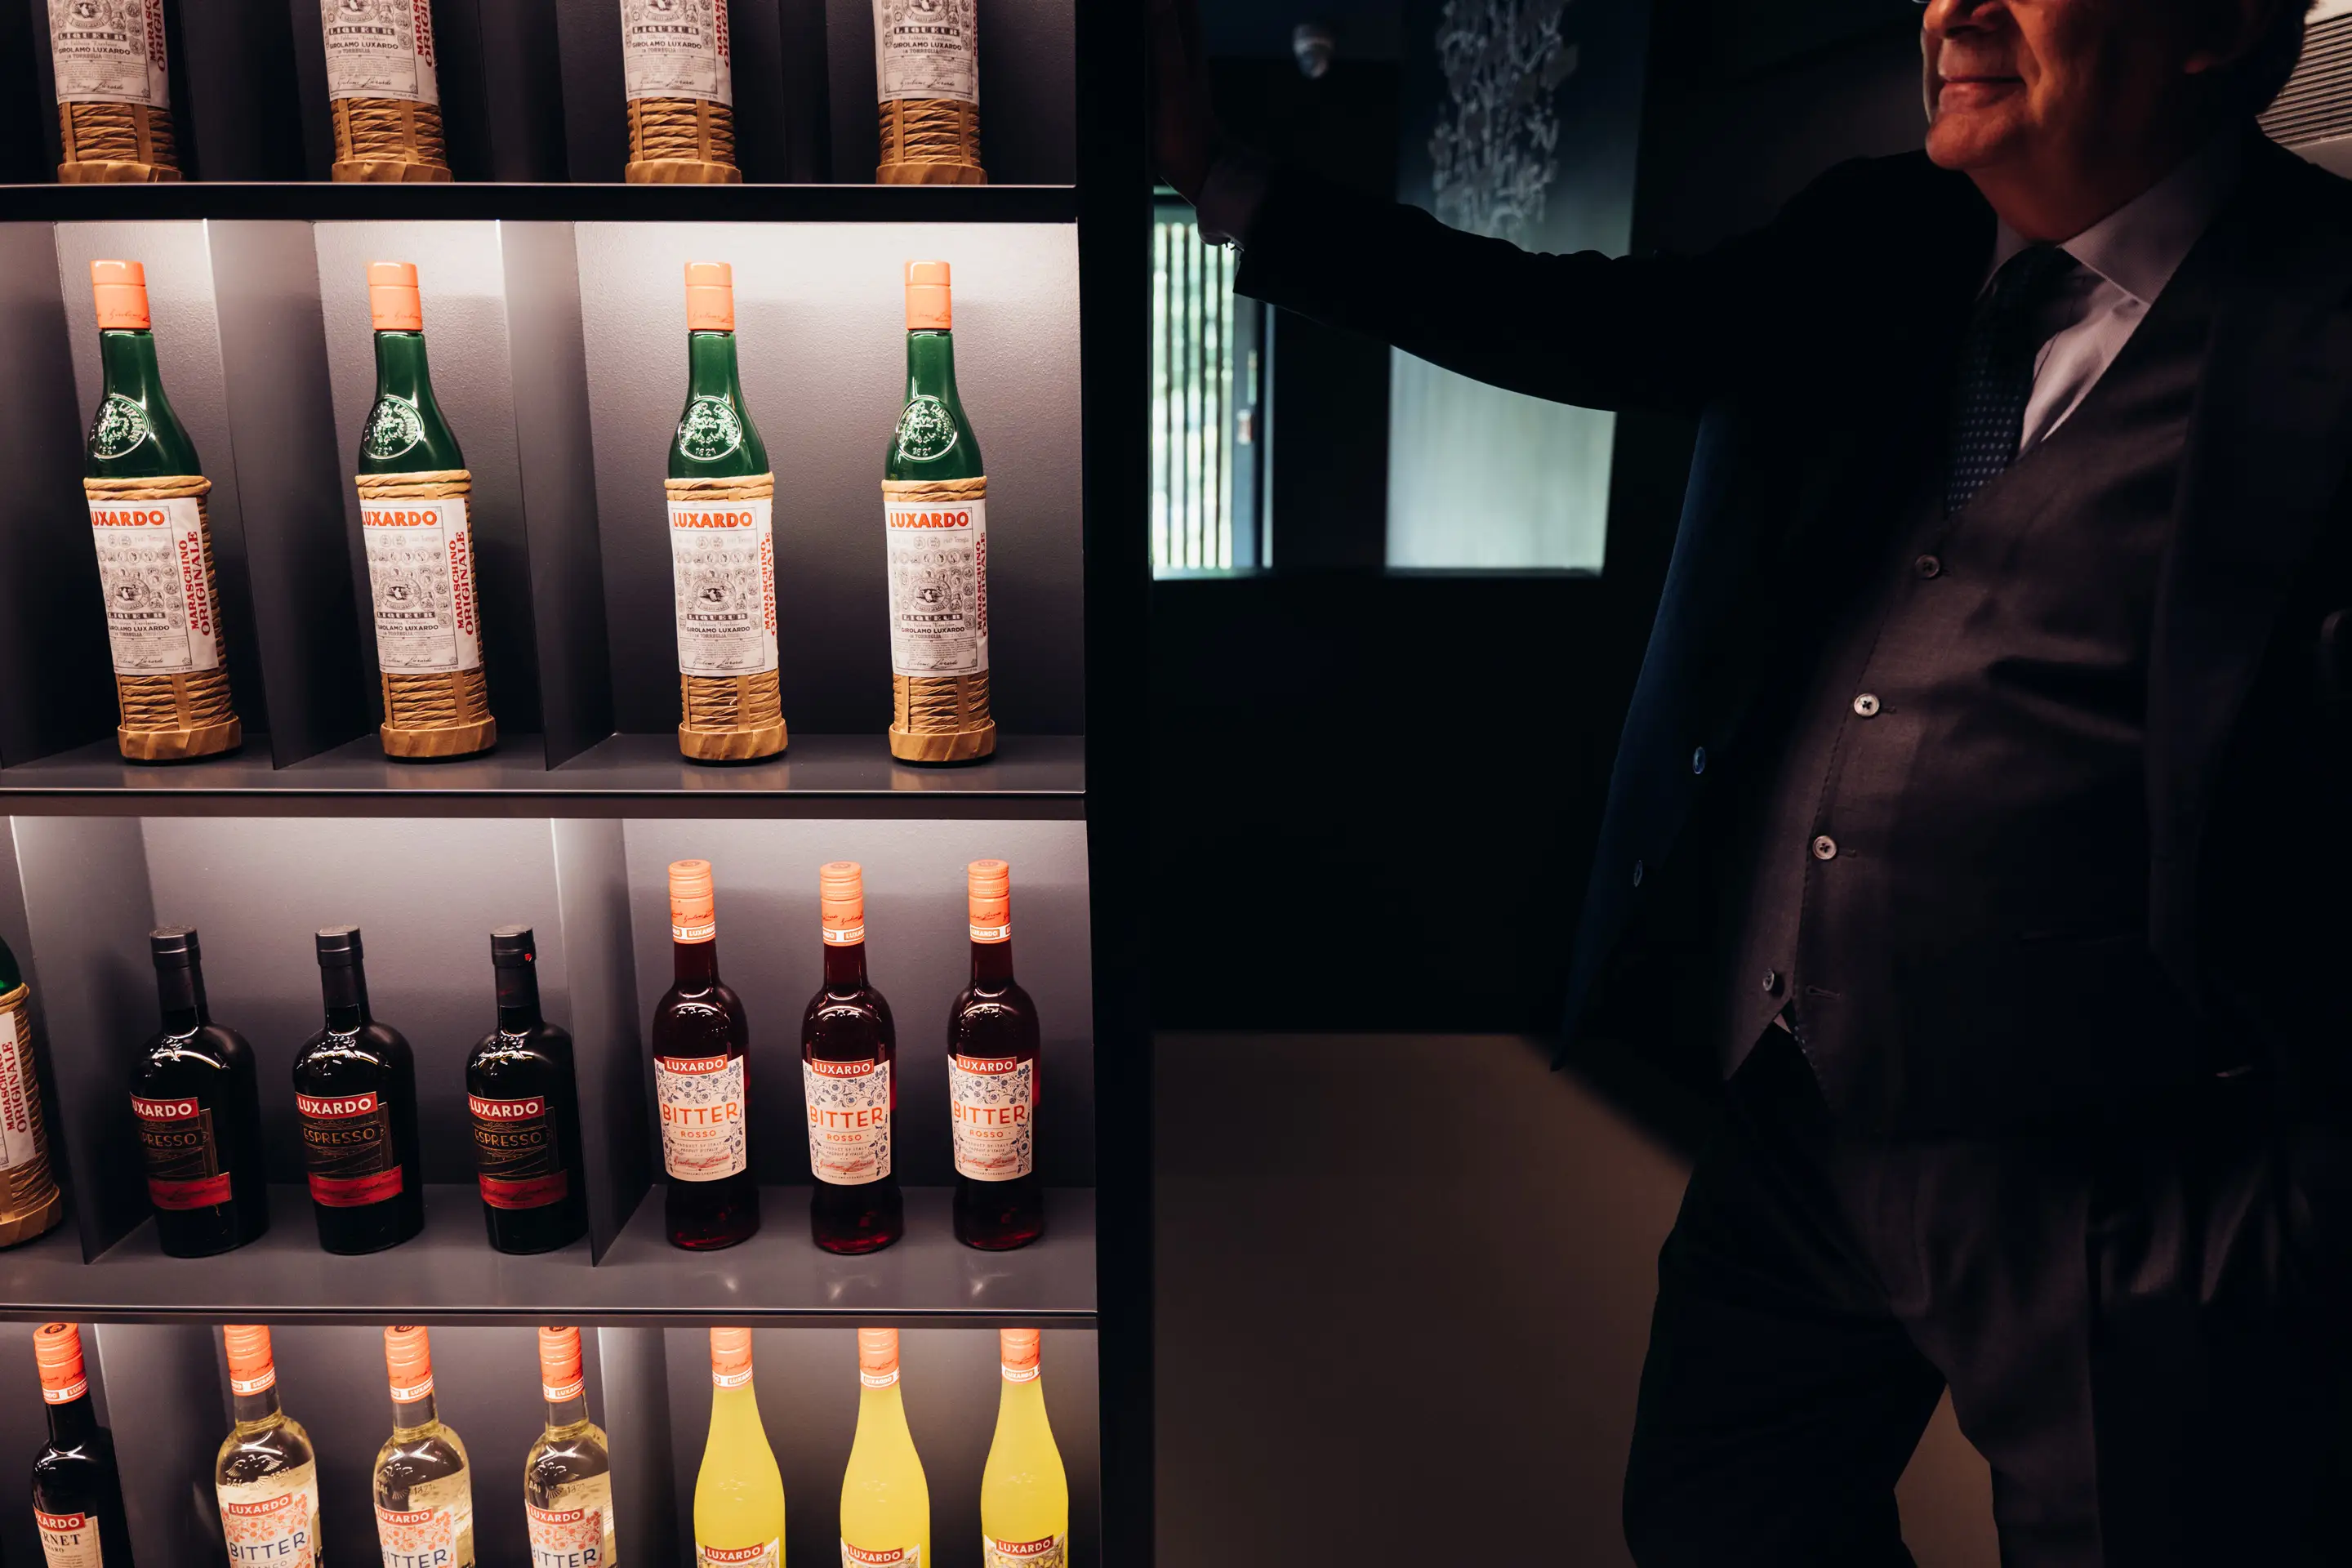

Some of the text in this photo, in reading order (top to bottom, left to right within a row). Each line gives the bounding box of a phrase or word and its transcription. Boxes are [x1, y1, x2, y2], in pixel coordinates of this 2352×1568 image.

[92, 47, 131, 56] LUXARDO
[329, 42, 359, 50] GIROLAMO
[667, 42, 702, 50] LUXARDO
[930, 42, 962, 51] LUXARDO
[91, 510, 165, 527] UXARDO
[673, 512, 753, 528] LUXARDO
[890, 511, 969, 528] LUXARDO
[179, 540, 199, 631] MARASCHINO
[188, 531, 211, 636] ORIGINALE
[449, 540, 465, 630] MARASCHINO
[456, 531, 474, 636] ORIGINALE
[760, 541, 770, 630] MARASCHINO
[666, 1058, 724, 1071] LUXARDO
[814, 1062, 871, 1075] LUXARDO
[959, 1058, 1013, 1071] LUXARDO
[2, 1041, 28, 1133] ORIGINALE
[132, 1099, 193, 1117] UXARDO
[297, 1098, 372, 1115] LUXARDO
[470, 1098, 539, 1117] LUXARDO
[662, 1102, 738, 1125] BITTER
[953, 1100, 1027, 1125] BITTER
[809, 1105, 884, 1129] BITTER
[142, 1133, 197, 1147] PRESSO
[303, 1128, 376, 1144] ESPRESSO
[474, 1129, 541, 1147] ESPRESSO
[680, 1129, 717, 1138] ROSSO
[826, 1134, 862, 1142] ROSSO
[969, 1129, 1004, 1138] ROSSO
[231, 1496, 289, 1514] LUXARDO
[378, 1508, 430, 1523] LUXARDO
[529, 1506, 581, 1522] LUXARDO
[38, 1517, 80, 1529] XARDO
[229, 1531, 306, 1561] BITTER
[707, 1546, 760, 1561] LUXARDO
[850, 1546, 901, 1562] LUXARDO
[999, 1539, 1051, 1553] LUXARDO
